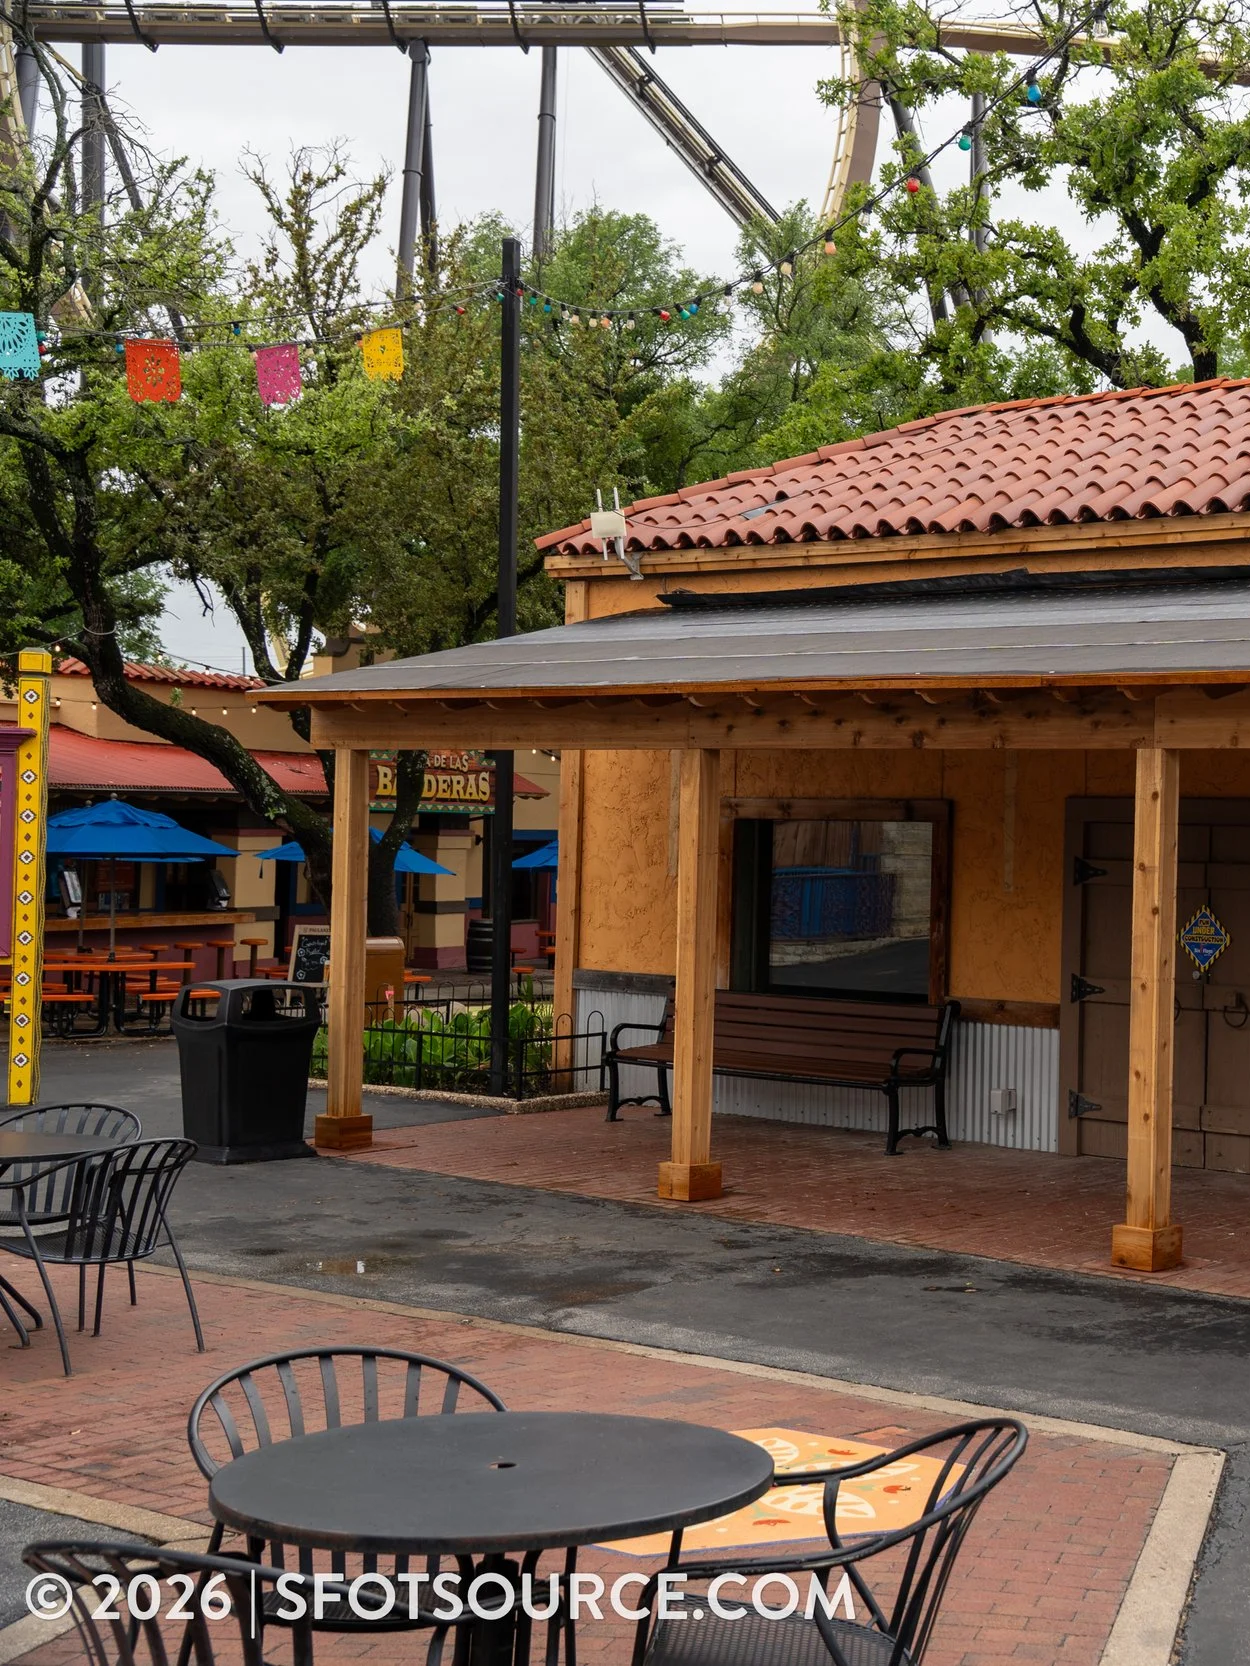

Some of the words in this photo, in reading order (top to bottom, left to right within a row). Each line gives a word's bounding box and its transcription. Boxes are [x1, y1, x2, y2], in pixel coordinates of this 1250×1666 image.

[434, 754, 447, 768] DE
[449, 754, 469, 773] LAS
[376, 764, 491, 802] BDERAS
